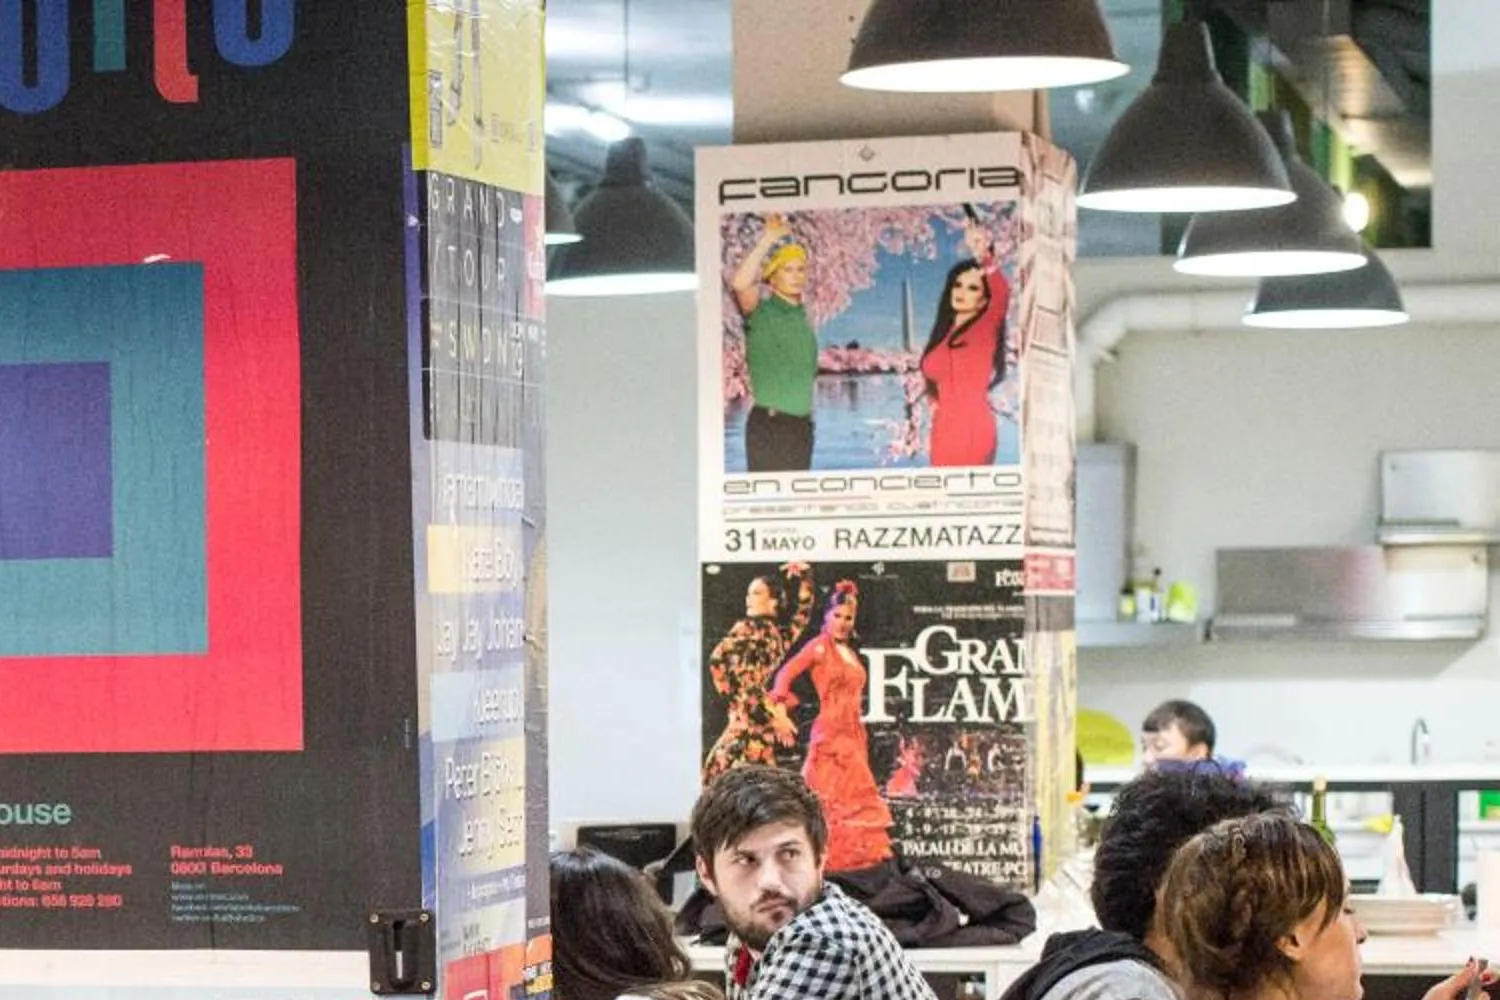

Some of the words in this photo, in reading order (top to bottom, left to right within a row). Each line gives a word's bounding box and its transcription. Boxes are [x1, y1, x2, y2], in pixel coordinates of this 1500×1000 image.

[723, 478, 781, 495] en
[791, 471, 1023, 493] concierto
[724, 529, 758, 552] 31
[762, 535, 816, 551] MAYO
[834, 524, 1023, 550] RAZZMATAZZ
[55, 848, 69, 859] to
[46, 863, 72, 876] and
[74, 863, 133, 876] holidays
[211, 861, 284, 876] Barcelona
[15, 880, 29, 891] to
